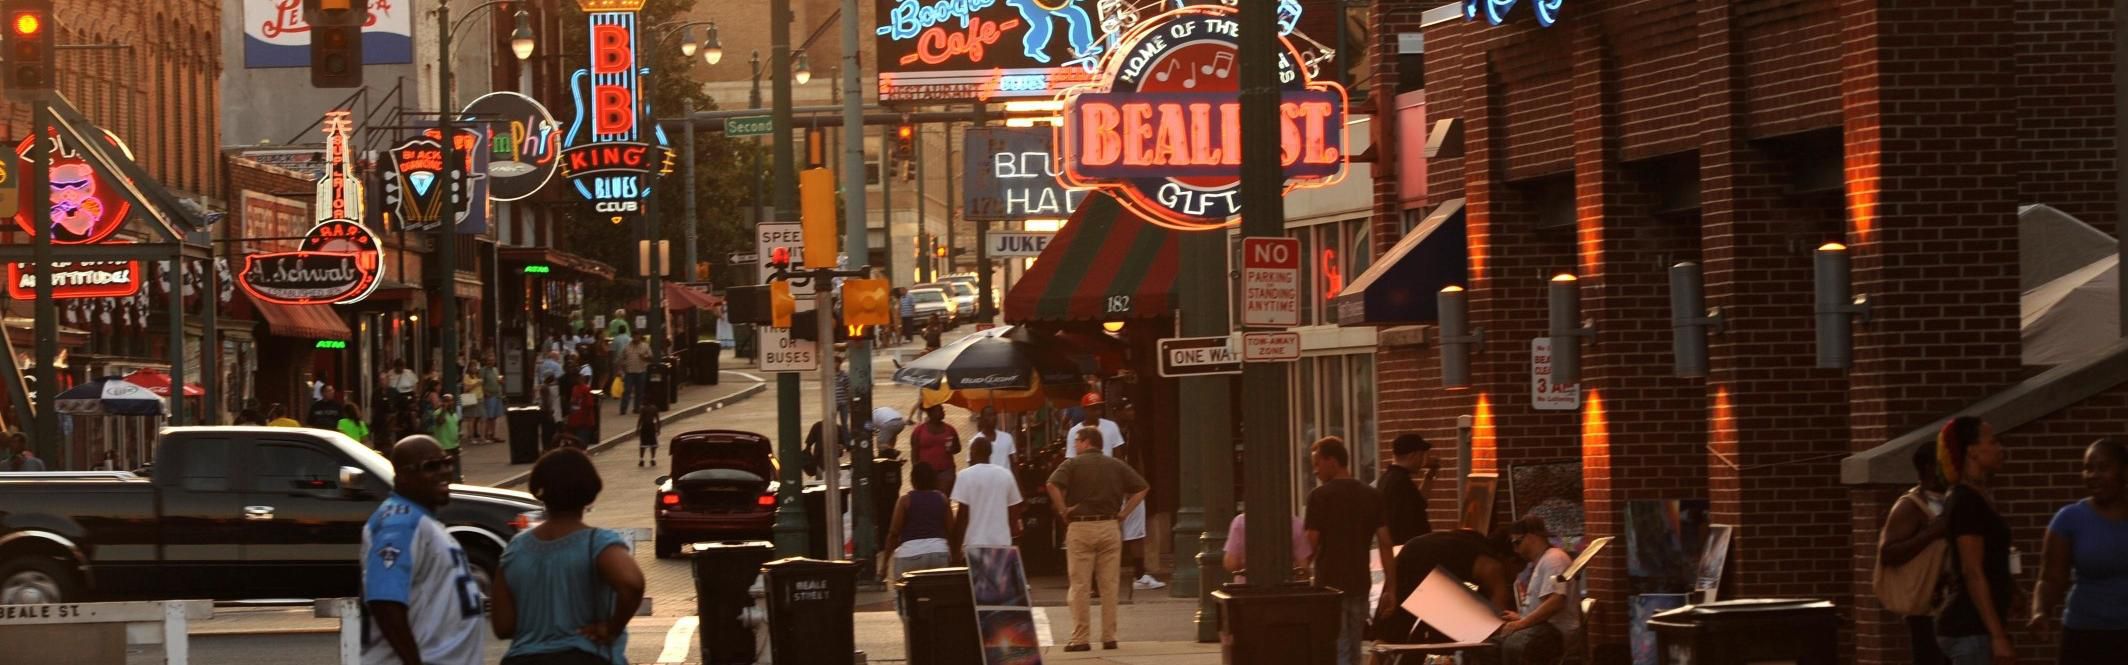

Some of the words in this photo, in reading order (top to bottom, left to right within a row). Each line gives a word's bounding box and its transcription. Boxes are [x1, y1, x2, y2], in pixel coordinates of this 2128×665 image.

[917, 17, 1001, 64] Cafe
[594, 24, 632, 74] B
[1121, 35, 1168, 84] HOME
[1170, 20, 1197, 39] OF
[1204, 19, 1239, 38] THE
[596, 84, 633, 134] B
[728, 120, 773, 133] Second
[994, 151, 1066, 178] BLU
[594, 176, 638, 199] BLUES
[595, 201, 638, 212] CLUB
[1158, 183, 1242, 215] GIFT
[762, 231, 802, 243] SPEE
[1255, 244, 1289, 263] NO
[273, 258, 355, 282] Schwab
[1248, 272, 1292, 283] PARKING
[1248, 288, 1296, 300] STANDING
[1107, 296, 1130, 313] 182
[1247, 301, 1295, 312] ANYTIME
[779, 338, 797, 348] OR
[767, 353, 810, 364] BUSES
[1174, 351, 1205, 364] ONE
[1259, 347, 1285, 355] ZONE
[1537, 379, 1547, 394] 3
